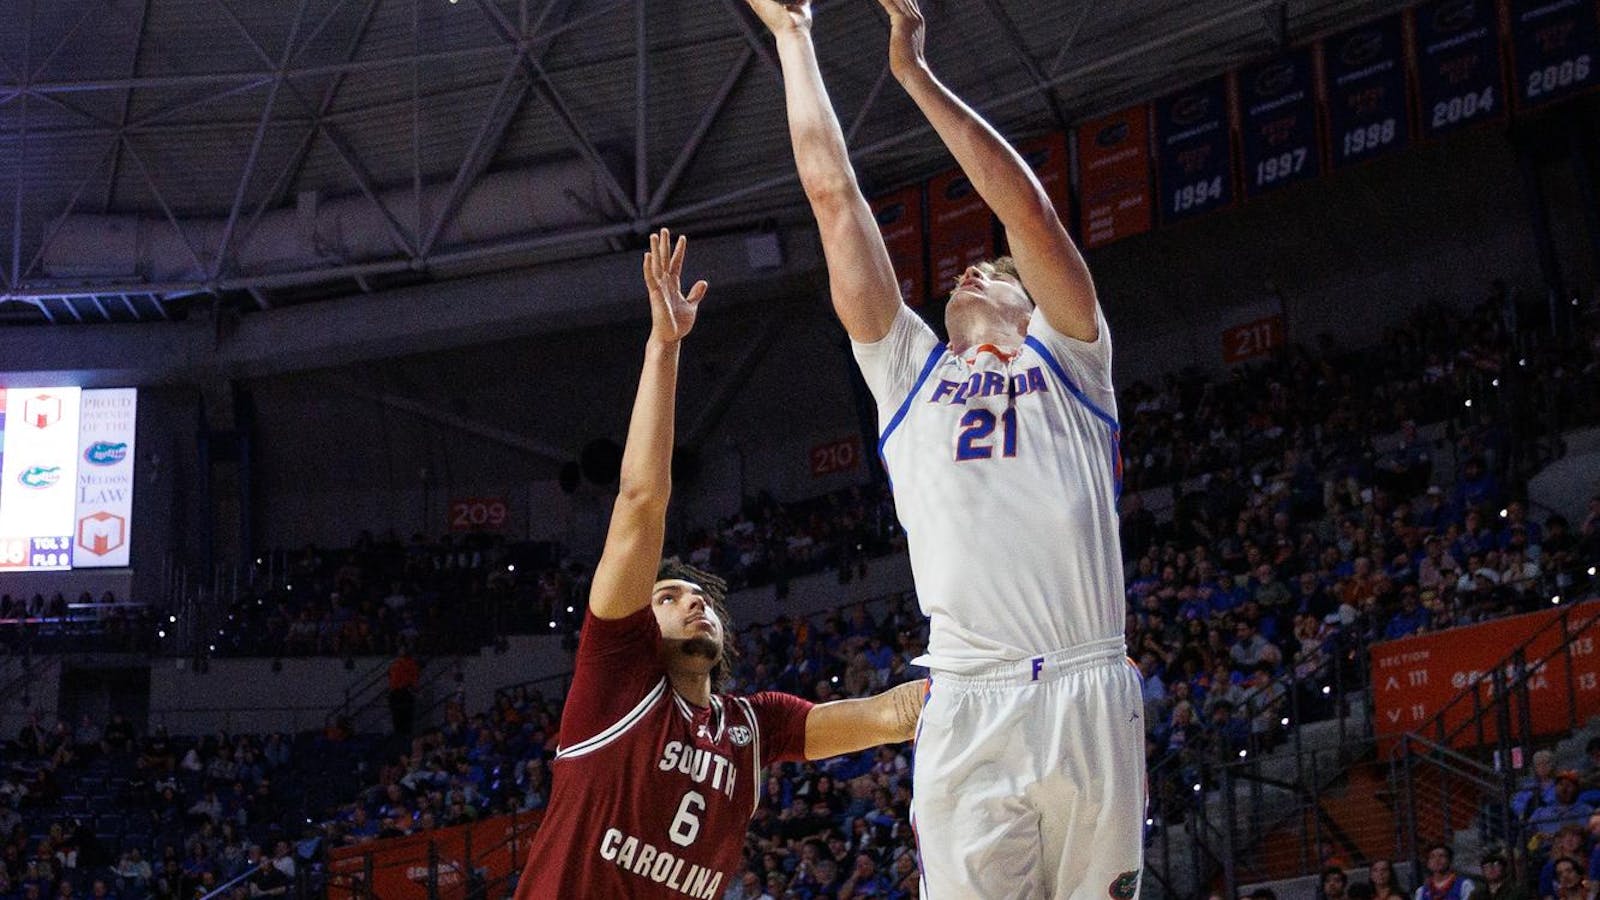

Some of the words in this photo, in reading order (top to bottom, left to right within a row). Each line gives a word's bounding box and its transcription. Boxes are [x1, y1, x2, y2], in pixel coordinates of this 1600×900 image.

[1526, 54, 1591, 98] 2006
[1432, 86, 1495, 128] 2004
[1343, 118, 1397, 157] 1998
[1256, 147, 1308, 187] 1997
[1173, 176, 1223, 214] 1994
[1234, 324, 1272, 355] 211
[84, 398, 131, 409] PROUD
[955, 406, 1018, 462] 21
[815, 443, 853, 473] 210
[79, 486, 127, 505] LAW
[453, 502, 506, 526] 209
[1031, 657, 1045, 682] F
[1379, 651, 1430, 668] SECTION
[1408, 669, 1428, 687] 111
[1411, 705, 1425, 721] 11
[658, 740, 737, 802] SOUTH
[668, 790, 706, 848] 6
[599, 827, 724, 900] CAROLINA
